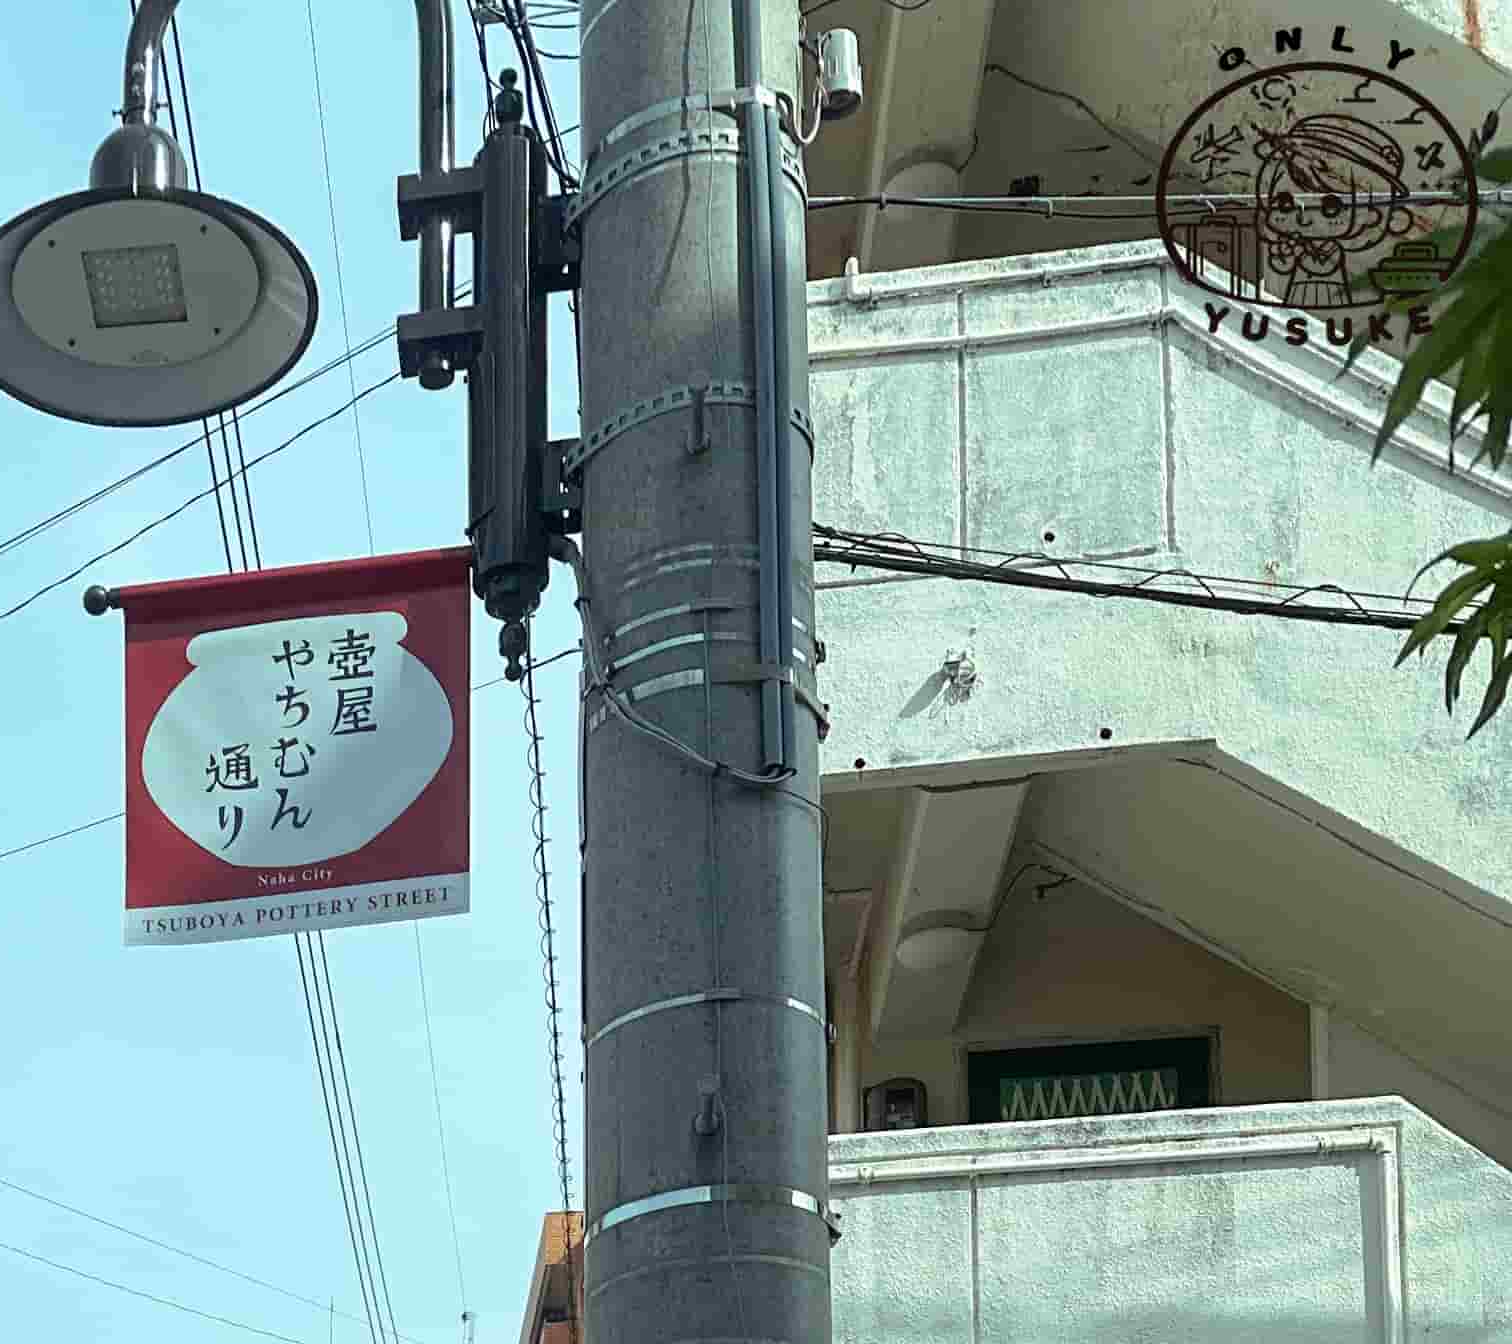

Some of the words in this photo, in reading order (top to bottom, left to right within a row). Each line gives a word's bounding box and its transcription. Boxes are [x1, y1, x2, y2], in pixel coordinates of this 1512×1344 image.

[270, 639, 317, 832] やちむん
[205, 743, 259, 850] 通り
[142, 912, 245, 935] TSUBOYA
[255, 896, 358, 924] POTTERY
[367, 885, 451, 911] STREET
[257, 872, 296, 888] Naha
[301, 866, 334, 885] City
